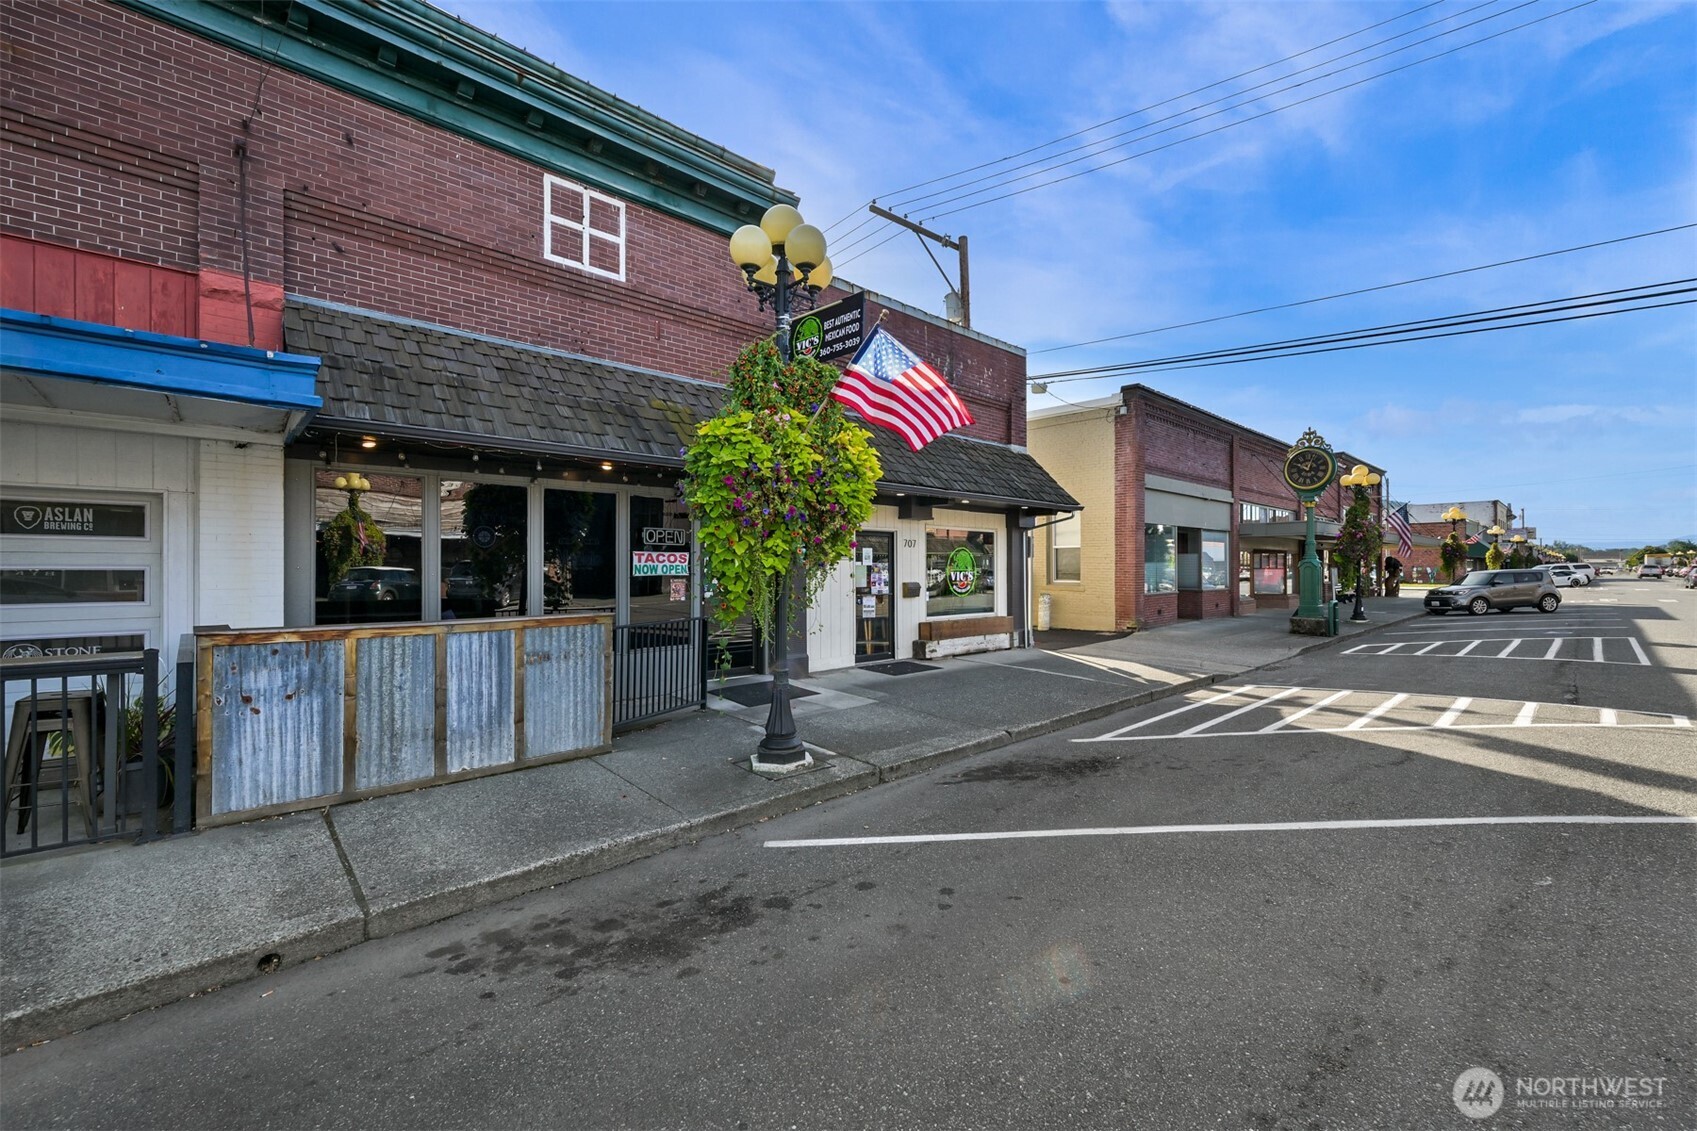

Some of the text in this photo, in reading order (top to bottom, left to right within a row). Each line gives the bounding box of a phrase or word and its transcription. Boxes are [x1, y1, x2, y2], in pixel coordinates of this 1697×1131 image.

[823, 308, 861, 331] BEST AUTHENTIC
[825, 322, 860, 342] MEXICAN FOOD
[796, 335, 820, 351] VIC'S
[819, 336, 861, 357] 360-755-3039
[44, 507, 93, 522] ASLAN
[44, 521, 82, 531] BREWING
[646, 529, 683, 544] OPEN
[903, 539, 917, 548] 707
[634, 552, 688, 564] TACOS
[634, 564, 688, 575] NOW OPEN
[950, 571, 974, 582] VIC'S
